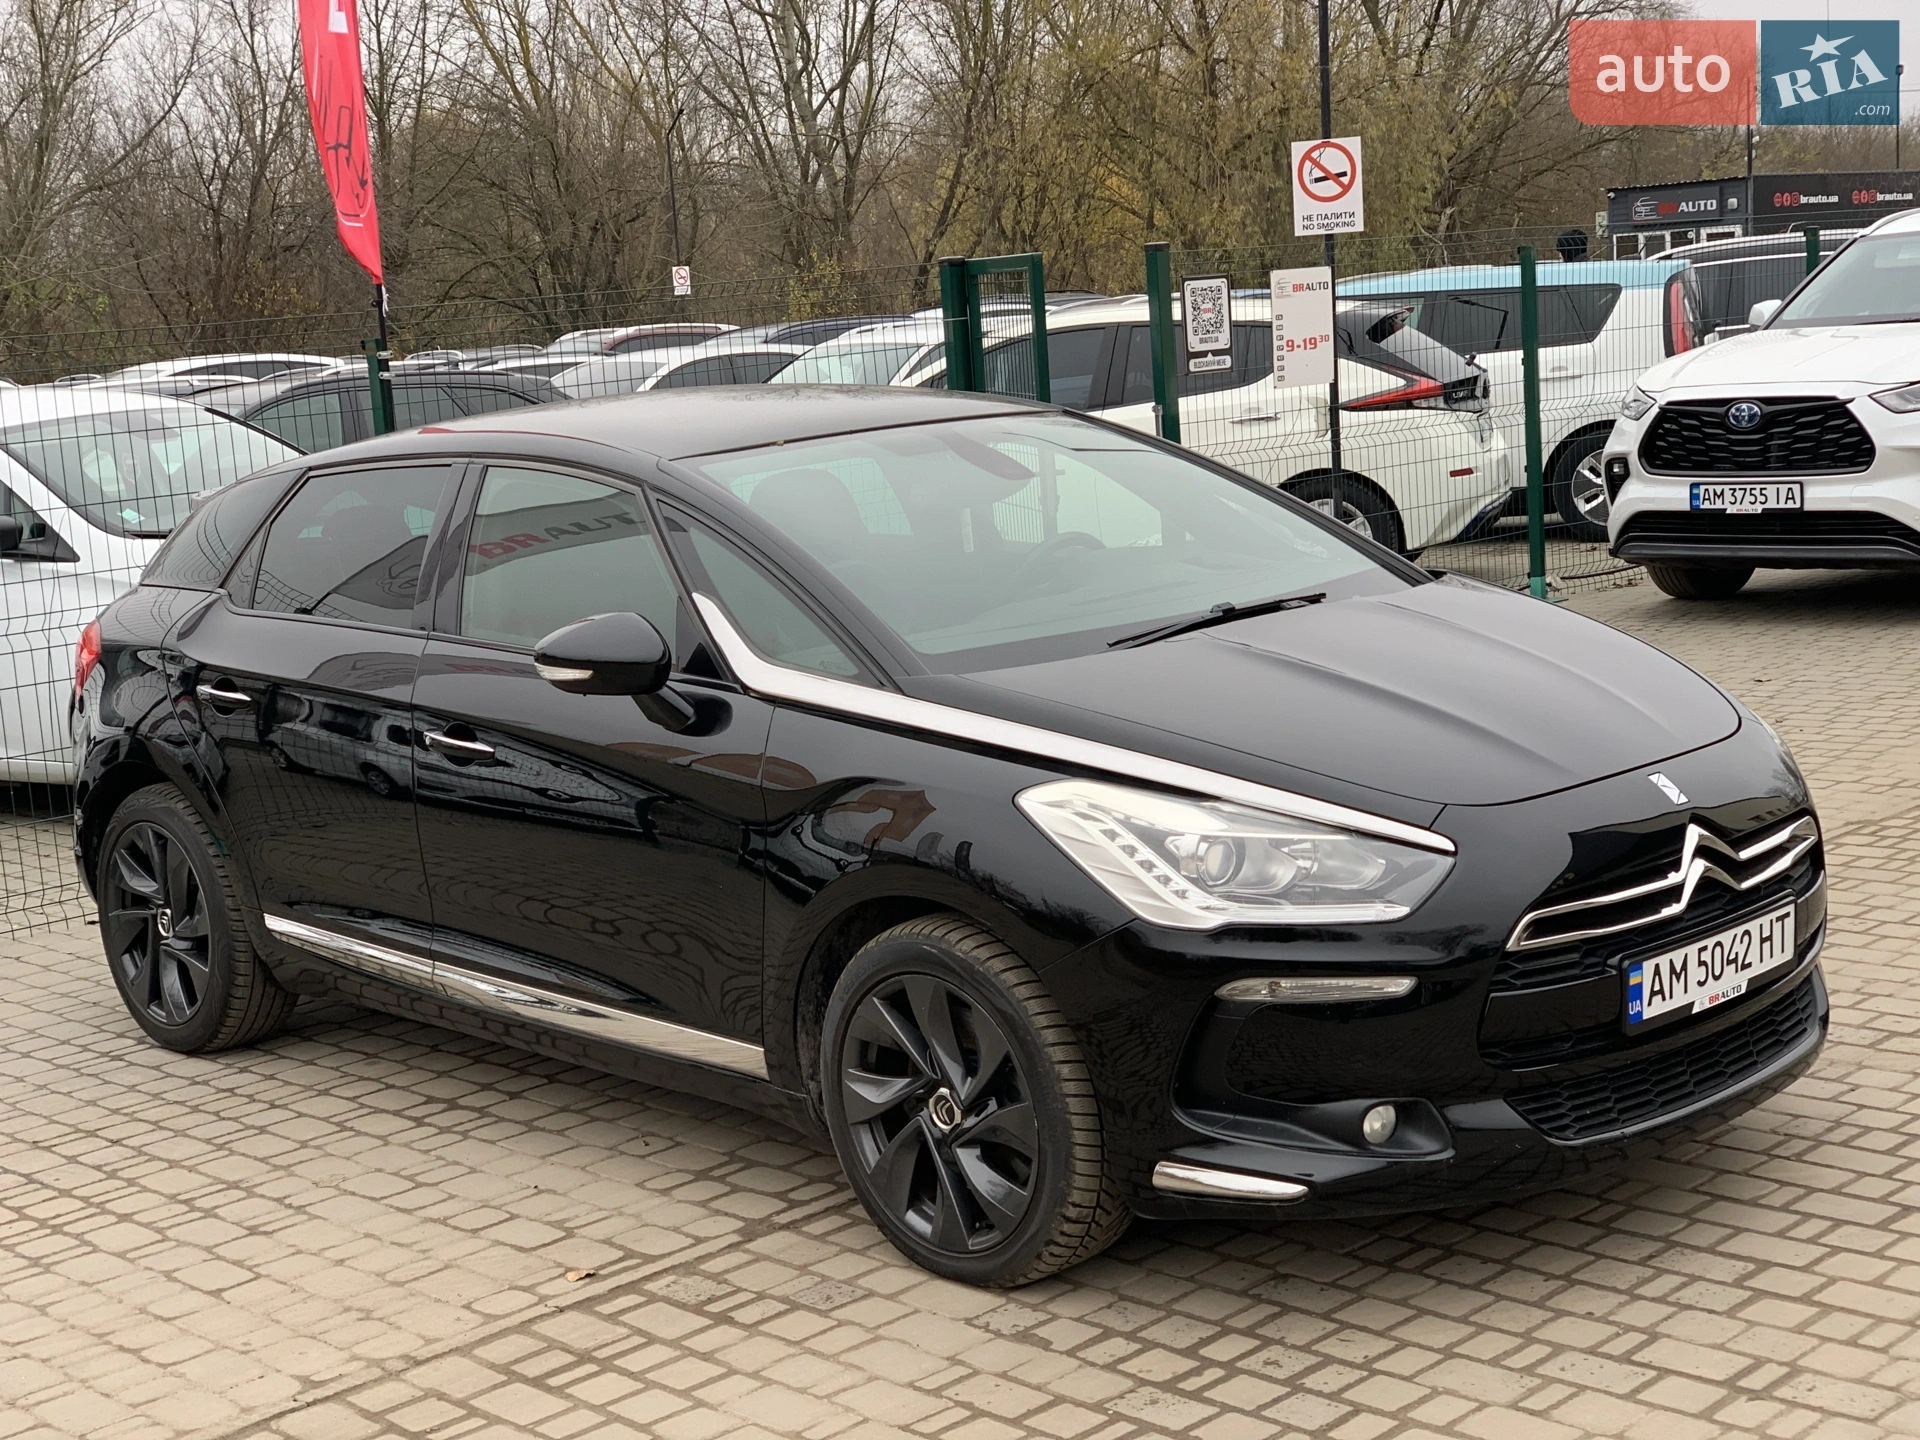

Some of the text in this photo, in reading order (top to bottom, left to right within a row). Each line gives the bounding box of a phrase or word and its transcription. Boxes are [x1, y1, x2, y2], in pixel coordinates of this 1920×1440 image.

[1800, 194, 1839, 204] brauto.ua
[1876, 192, 1913, 201] brauto.ua
[1302, 211, 1355, 222] НЕ ПАЛИТИ
[1302, 220, 1356, 231] NO SMOKING
[1292, 281, 1329, 293] BRAUTO
[1701, 487, 1797, 505] AM 3755 IA
[1647, 911, 1791, 1008] AM 5042 HT
[1708, 984, 1742, 1006] BRAUTO
[1628, 1000, 1642, 1016] UA
